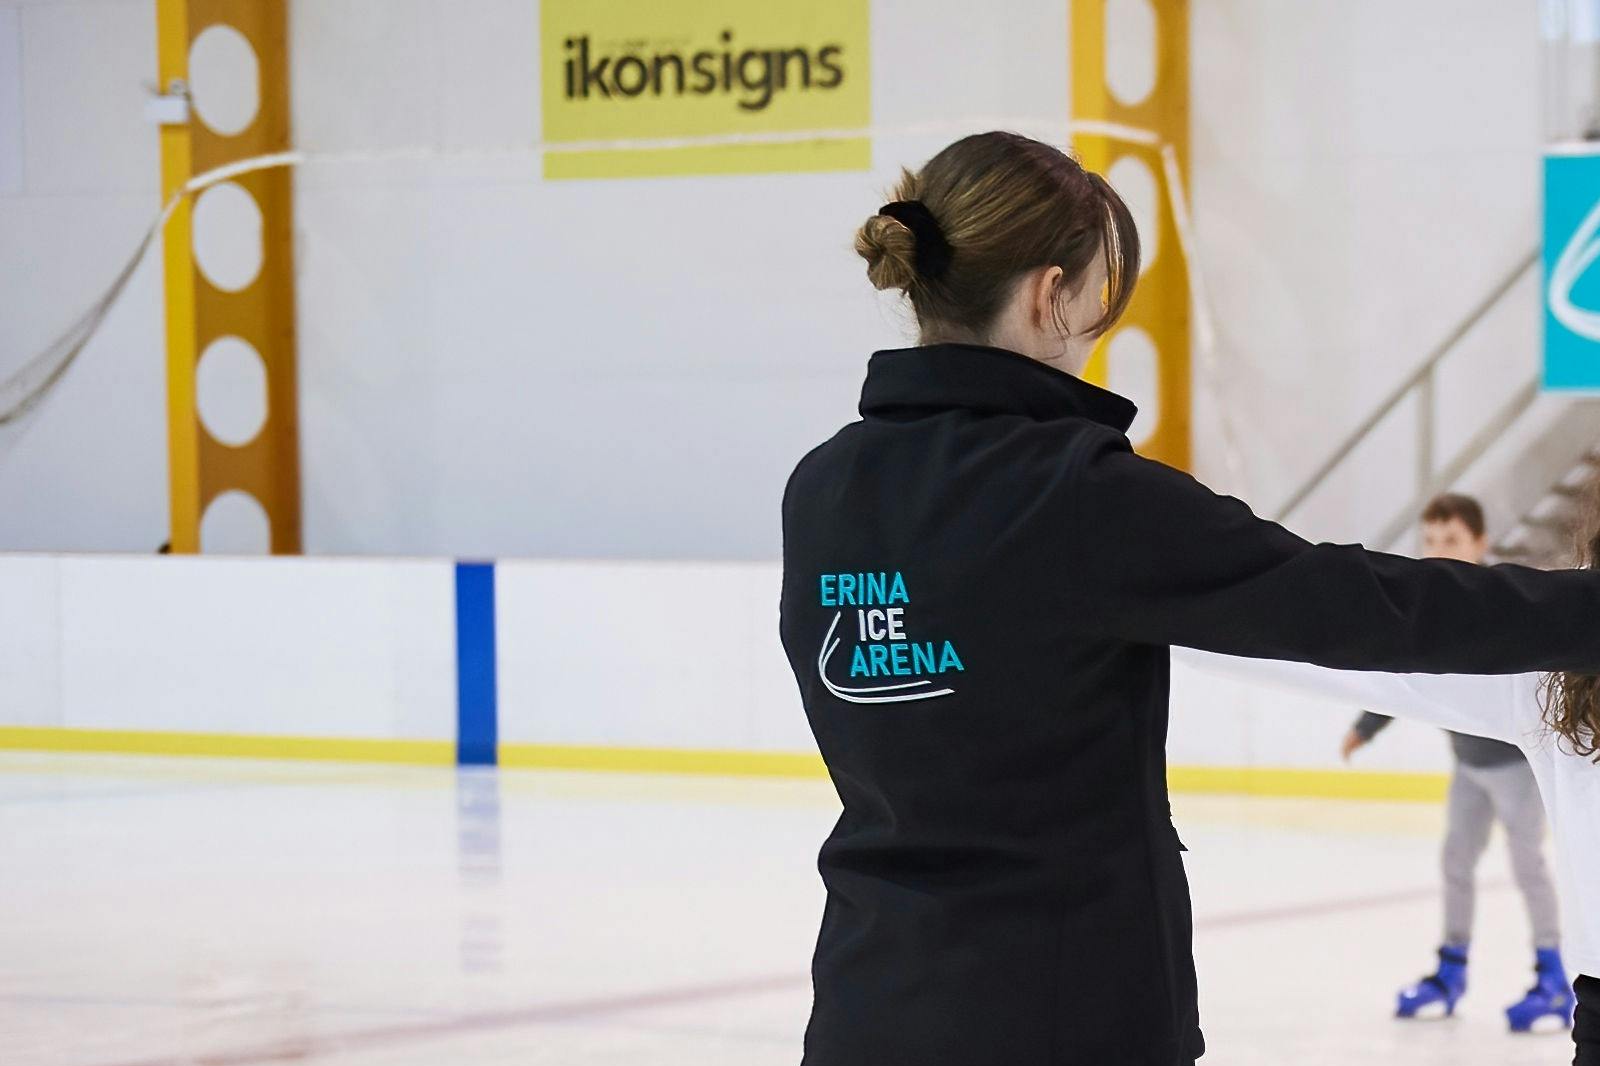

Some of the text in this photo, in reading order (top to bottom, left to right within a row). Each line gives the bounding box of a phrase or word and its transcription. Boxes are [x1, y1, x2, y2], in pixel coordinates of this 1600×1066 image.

[564, 30, 844, 112] ikonsigns
[820, 571, 910, 607] ERINA
[858, 607, 907, 642] ICE
[850, 640, 965, 677] ARENA
